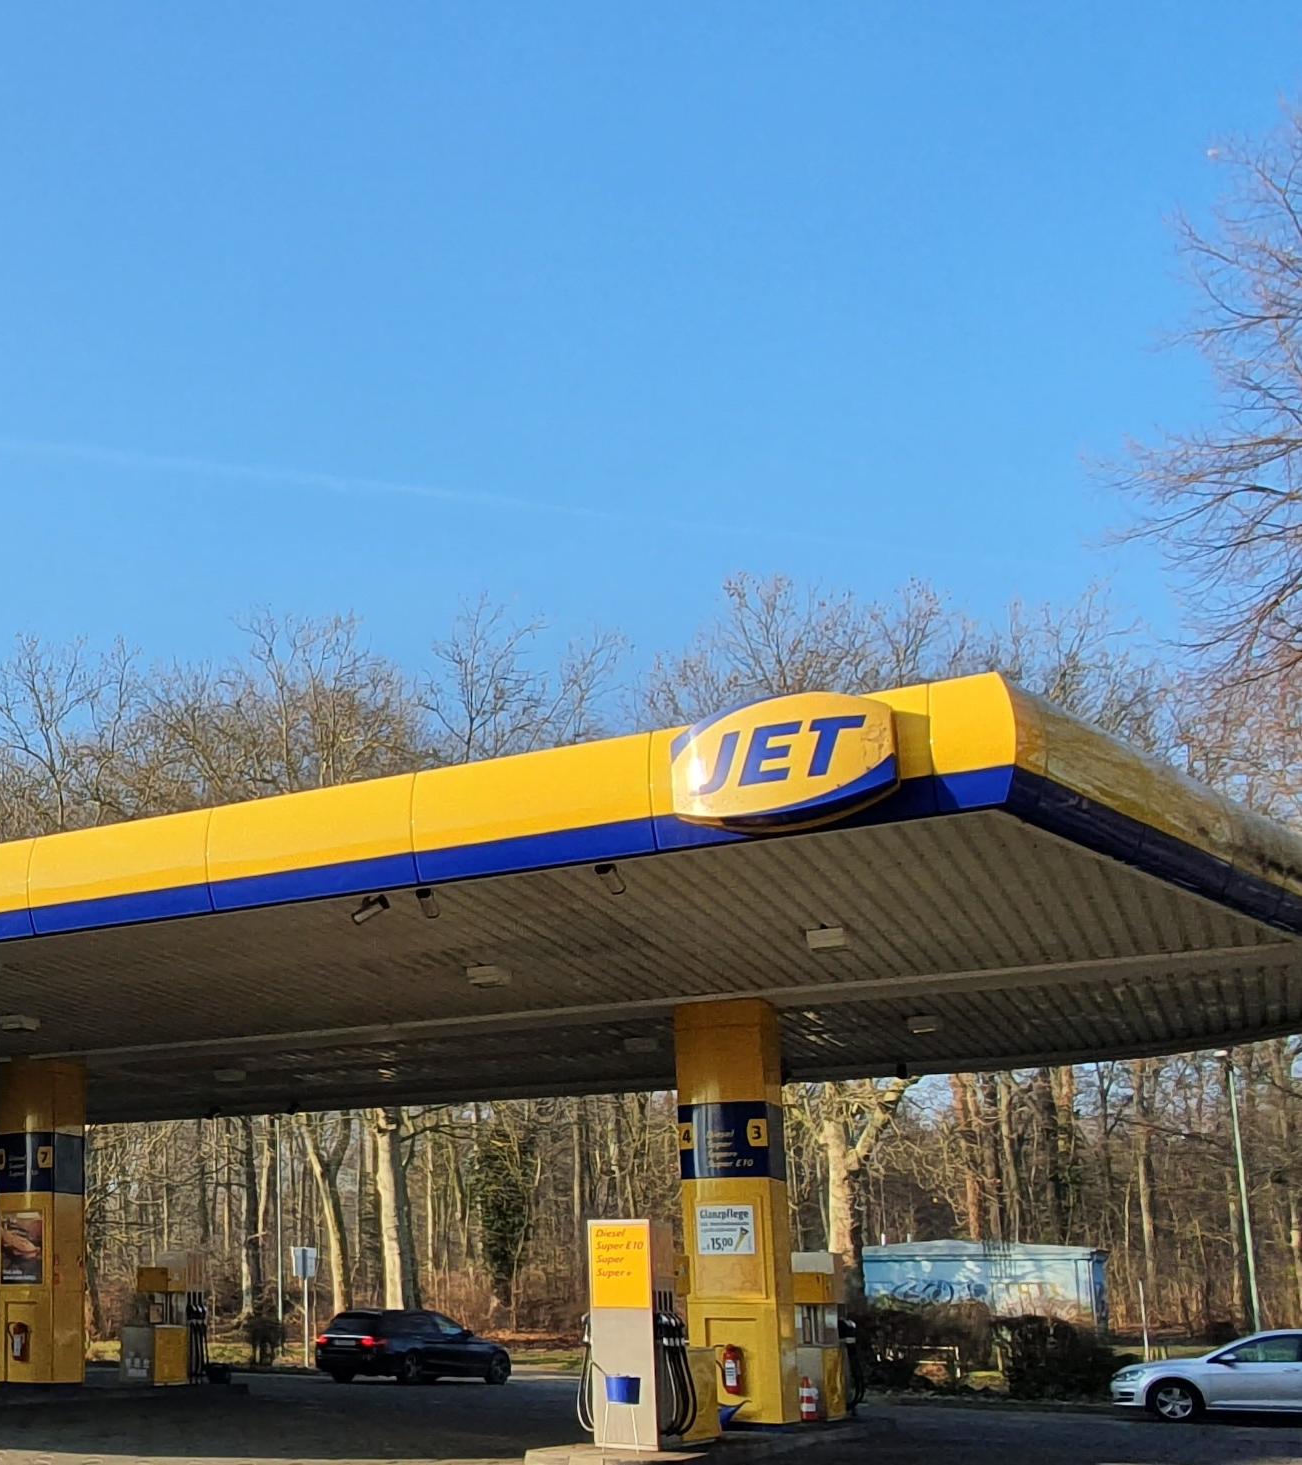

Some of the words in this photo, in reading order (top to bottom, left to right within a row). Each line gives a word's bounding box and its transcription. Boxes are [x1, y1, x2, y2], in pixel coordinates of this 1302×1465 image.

[689, 714, 867, 797] JET
[682, 1128, 692, 1144] 4
[751, 1125, 762, 1140] 3
[40, 1151, 49, 1164] 7
[700, 1208, 749, 1220] Glanzpflege
[595, 1228, 626, 1237] Diesel
[595, 1241, 624, 1252] Super
[595, 1254, 625, 1266] Super
